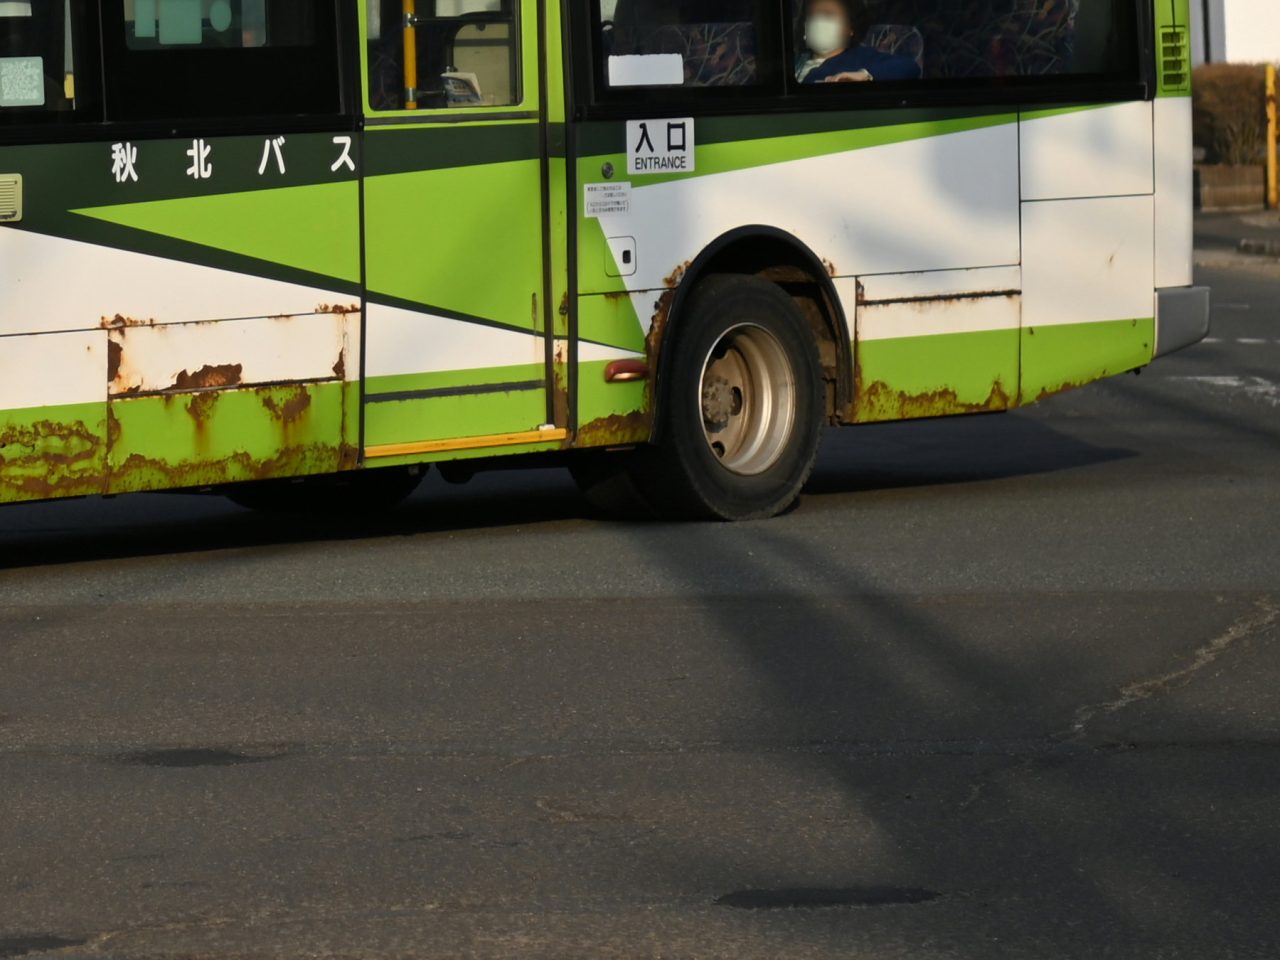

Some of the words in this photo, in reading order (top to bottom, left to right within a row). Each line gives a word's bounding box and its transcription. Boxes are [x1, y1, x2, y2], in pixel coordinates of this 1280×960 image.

[635, 121, 686, 153] 入口
[111, 136, 356, 182] 秋北バス
[635, 156, 686, 170] ENTRANCE
